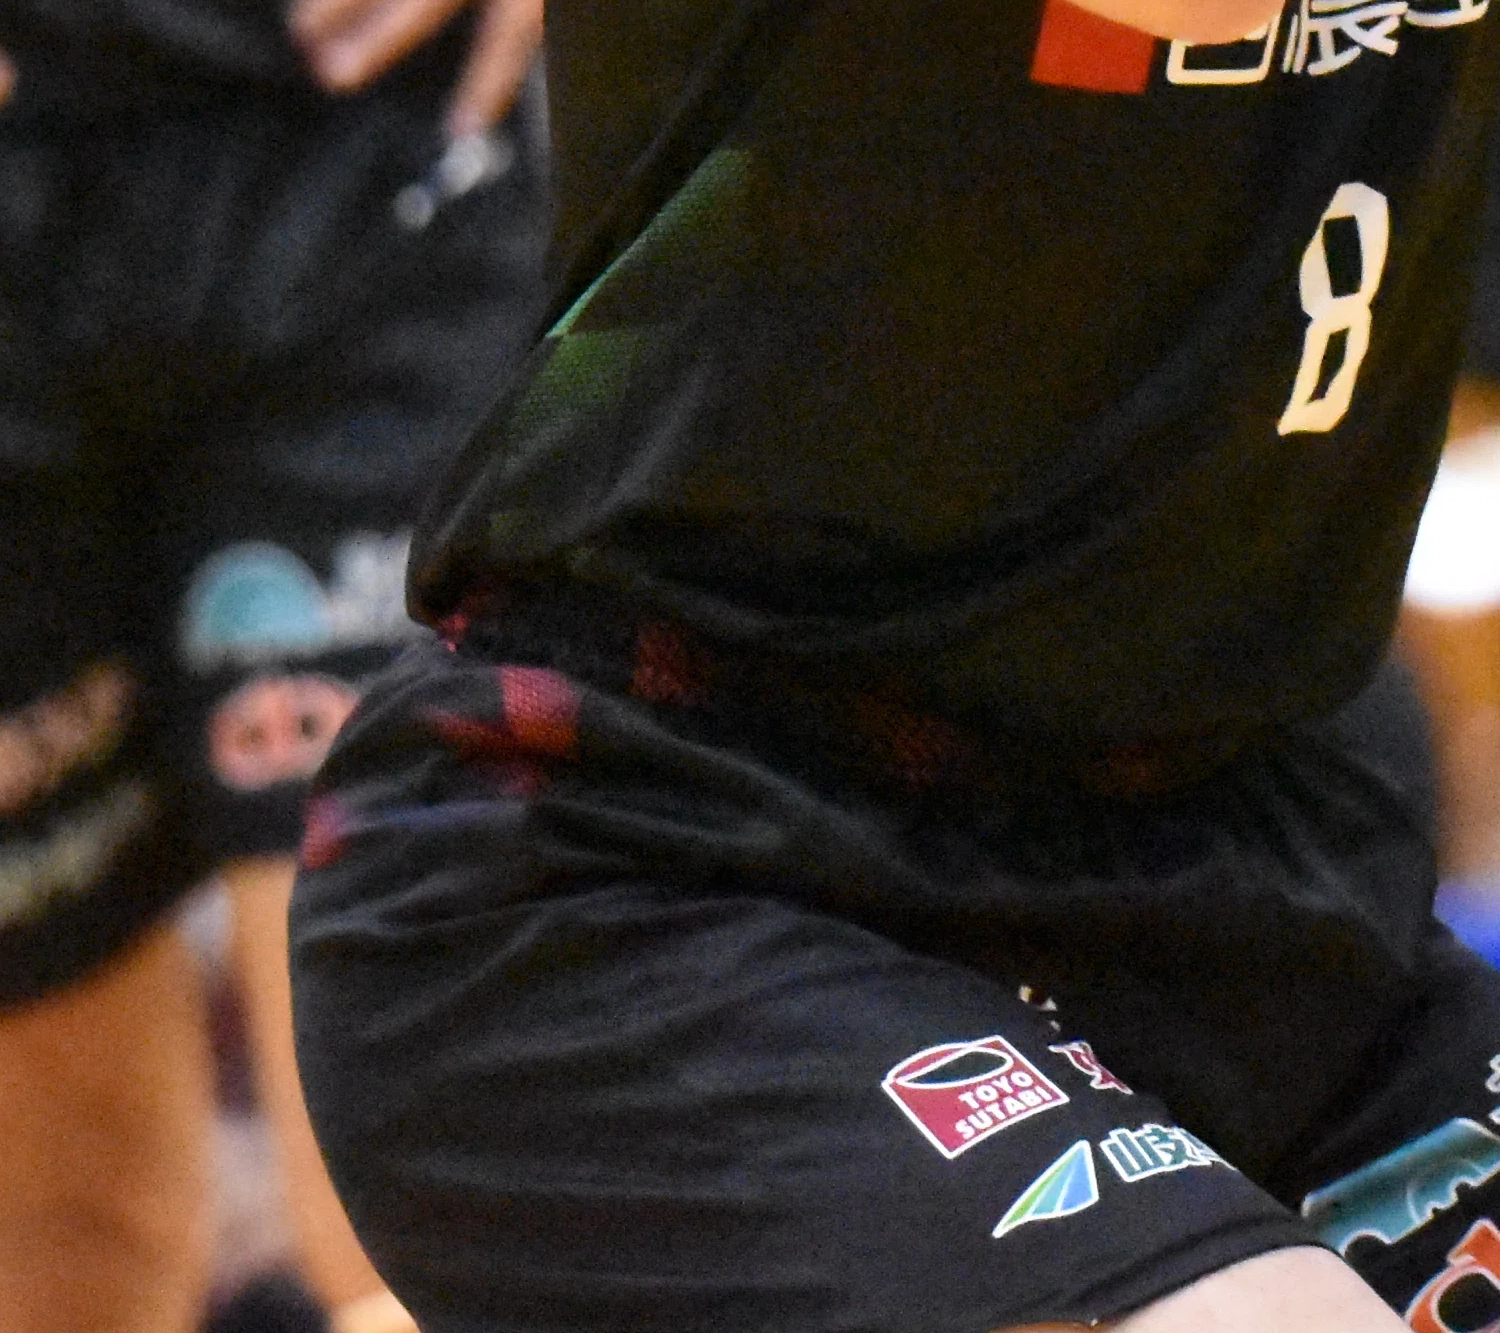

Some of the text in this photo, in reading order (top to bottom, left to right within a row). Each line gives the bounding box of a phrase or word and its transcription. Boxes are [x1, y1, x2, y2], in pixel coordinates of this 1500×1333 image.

[1278, 182, 1388, 434] 8
[954, 1085, 1053, 1140] SUTABI
[957, 1071, 1034, 1110] TOYO
